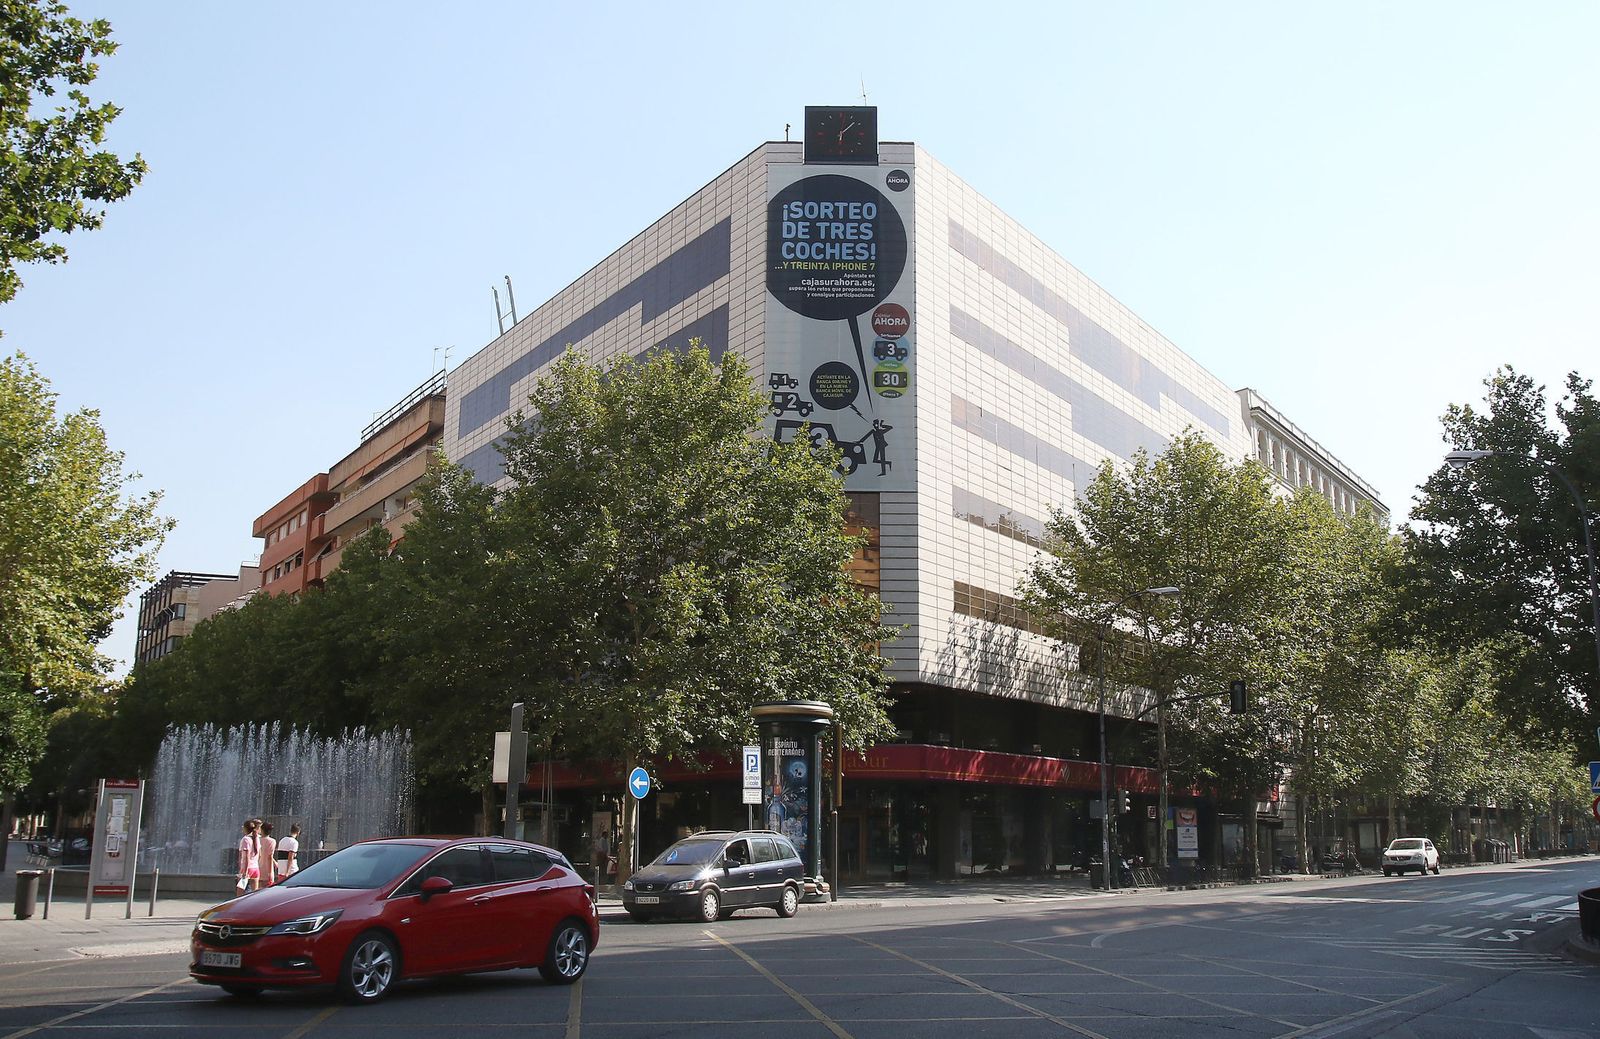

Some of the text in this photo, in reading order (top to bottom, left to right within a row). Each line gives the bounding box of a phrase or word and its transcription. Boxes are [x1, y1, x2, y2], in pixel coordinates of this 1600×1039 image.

[782, 202, 877, 220] ¡SORTEO
[782, 222, 874, 240] DE TRES
[782, 242, 876, 260] COCHES!
[790, 262, 830, 270] TREINTA
[832, 262, 868, 270] IPHONE
[801, 278, 876, 288] cajasurahora.es,
[874, 318, 908, 326] AHORA
[887, 343, 896, 355] 3
[782, 374, 787, 384] 1
[882, 373, 900, 386] 30
[786, 394, 797, 408] 2
[776, 739, 798, 748] ESPÍRITU
[1395, 920, 1536, 942] BUS
